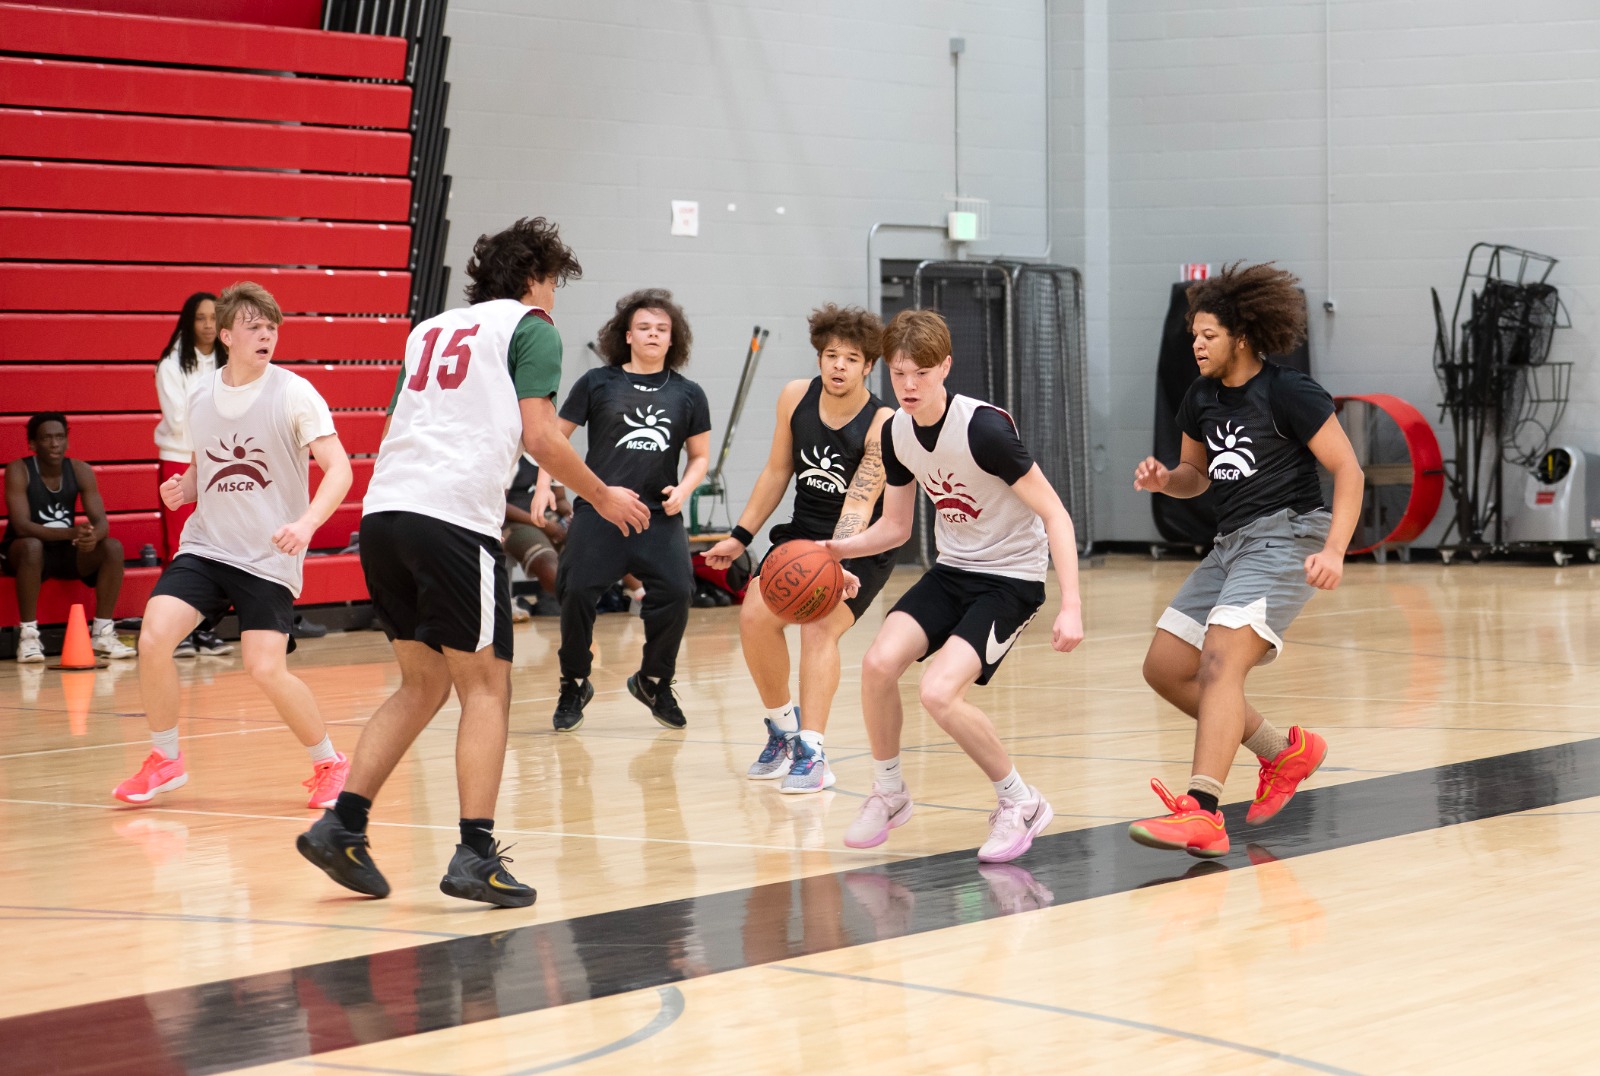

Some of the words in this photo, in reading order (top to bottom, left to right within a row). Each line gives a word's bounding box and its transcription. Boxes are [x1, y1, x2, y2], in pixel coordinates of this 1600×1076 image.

[407, 323, 480, 392] 15
[626, 440, 658, 452] MSCR
[1213, 468, 1241, 480] MSCR
[217, 481, 255, 493] MSCR
[806, 476, 836, 494] MSCR
[766, 562, 812, 603] MSCR
